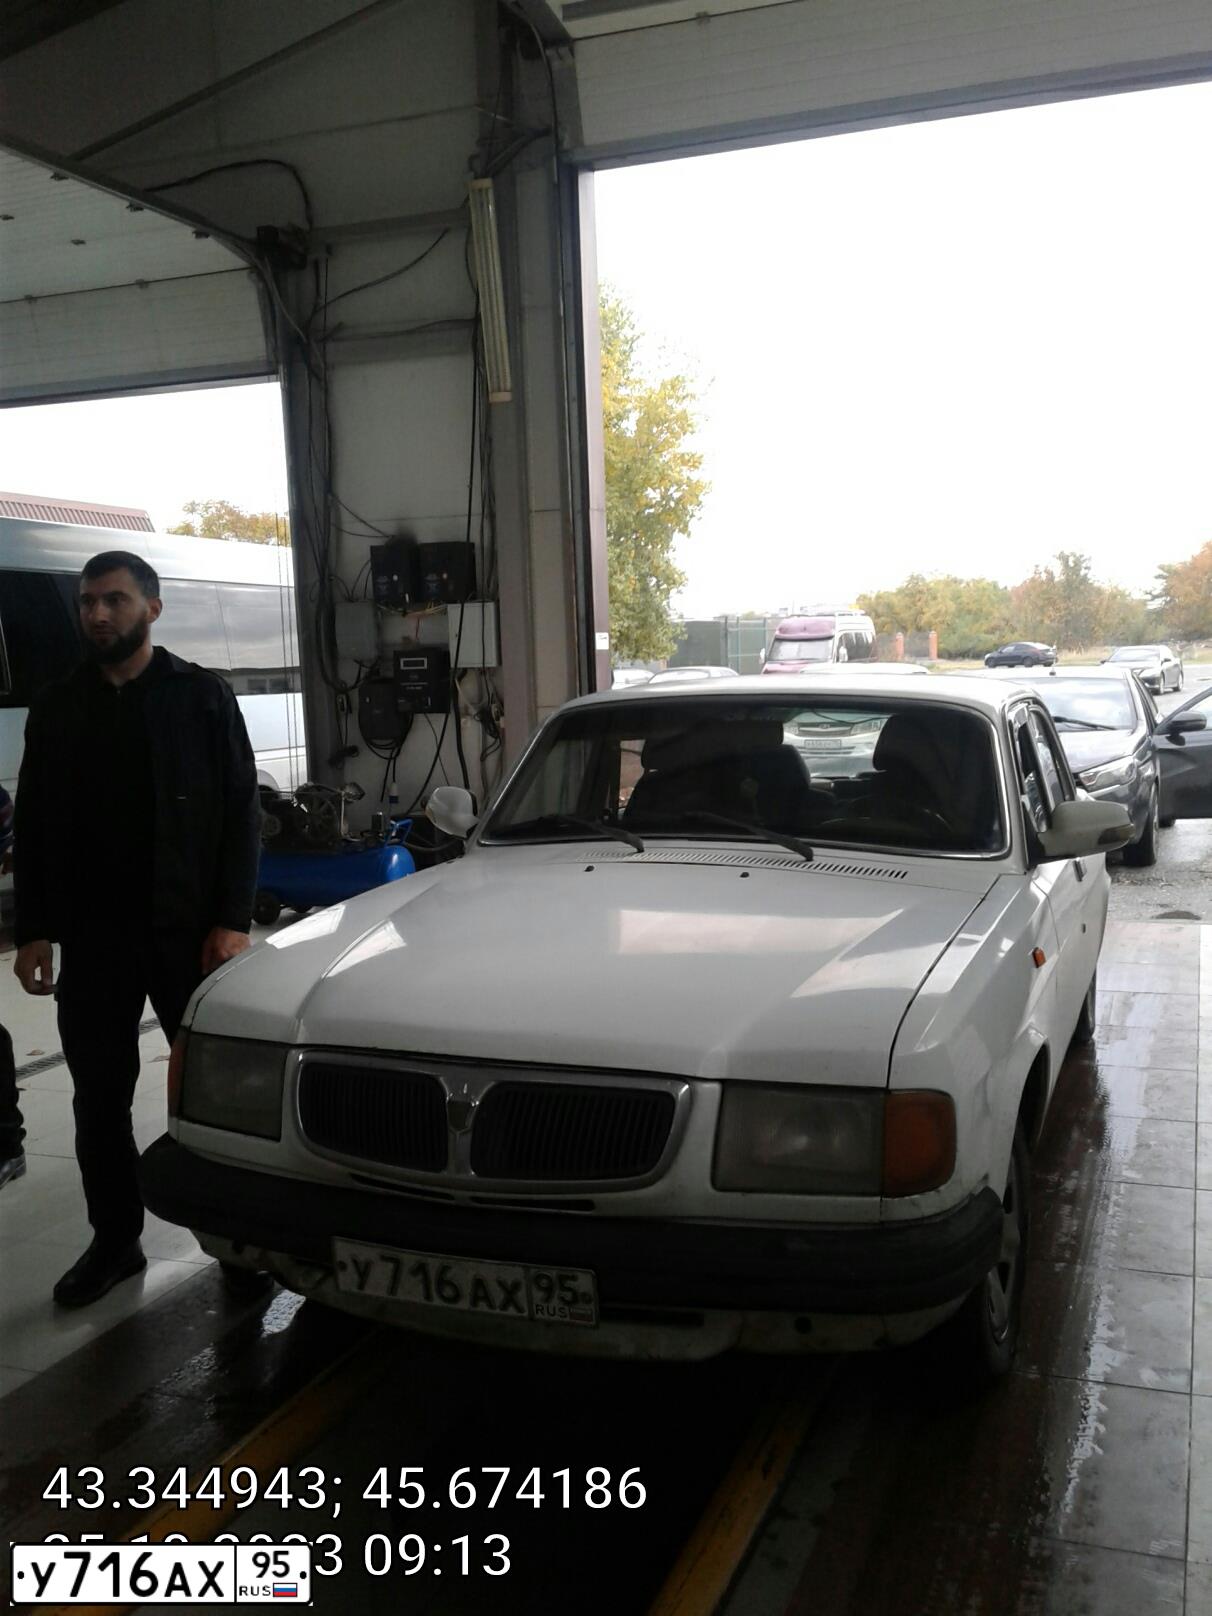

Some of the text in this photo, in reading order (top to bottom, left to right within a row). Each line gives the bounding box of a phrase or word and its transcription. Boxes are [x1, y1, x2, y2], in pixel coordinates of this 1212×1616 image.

[352, 1254, 528, 1315] У716АХ
[533, 1271, 580, 1305] 95
[535, 1304, 569, 1319] RUS
